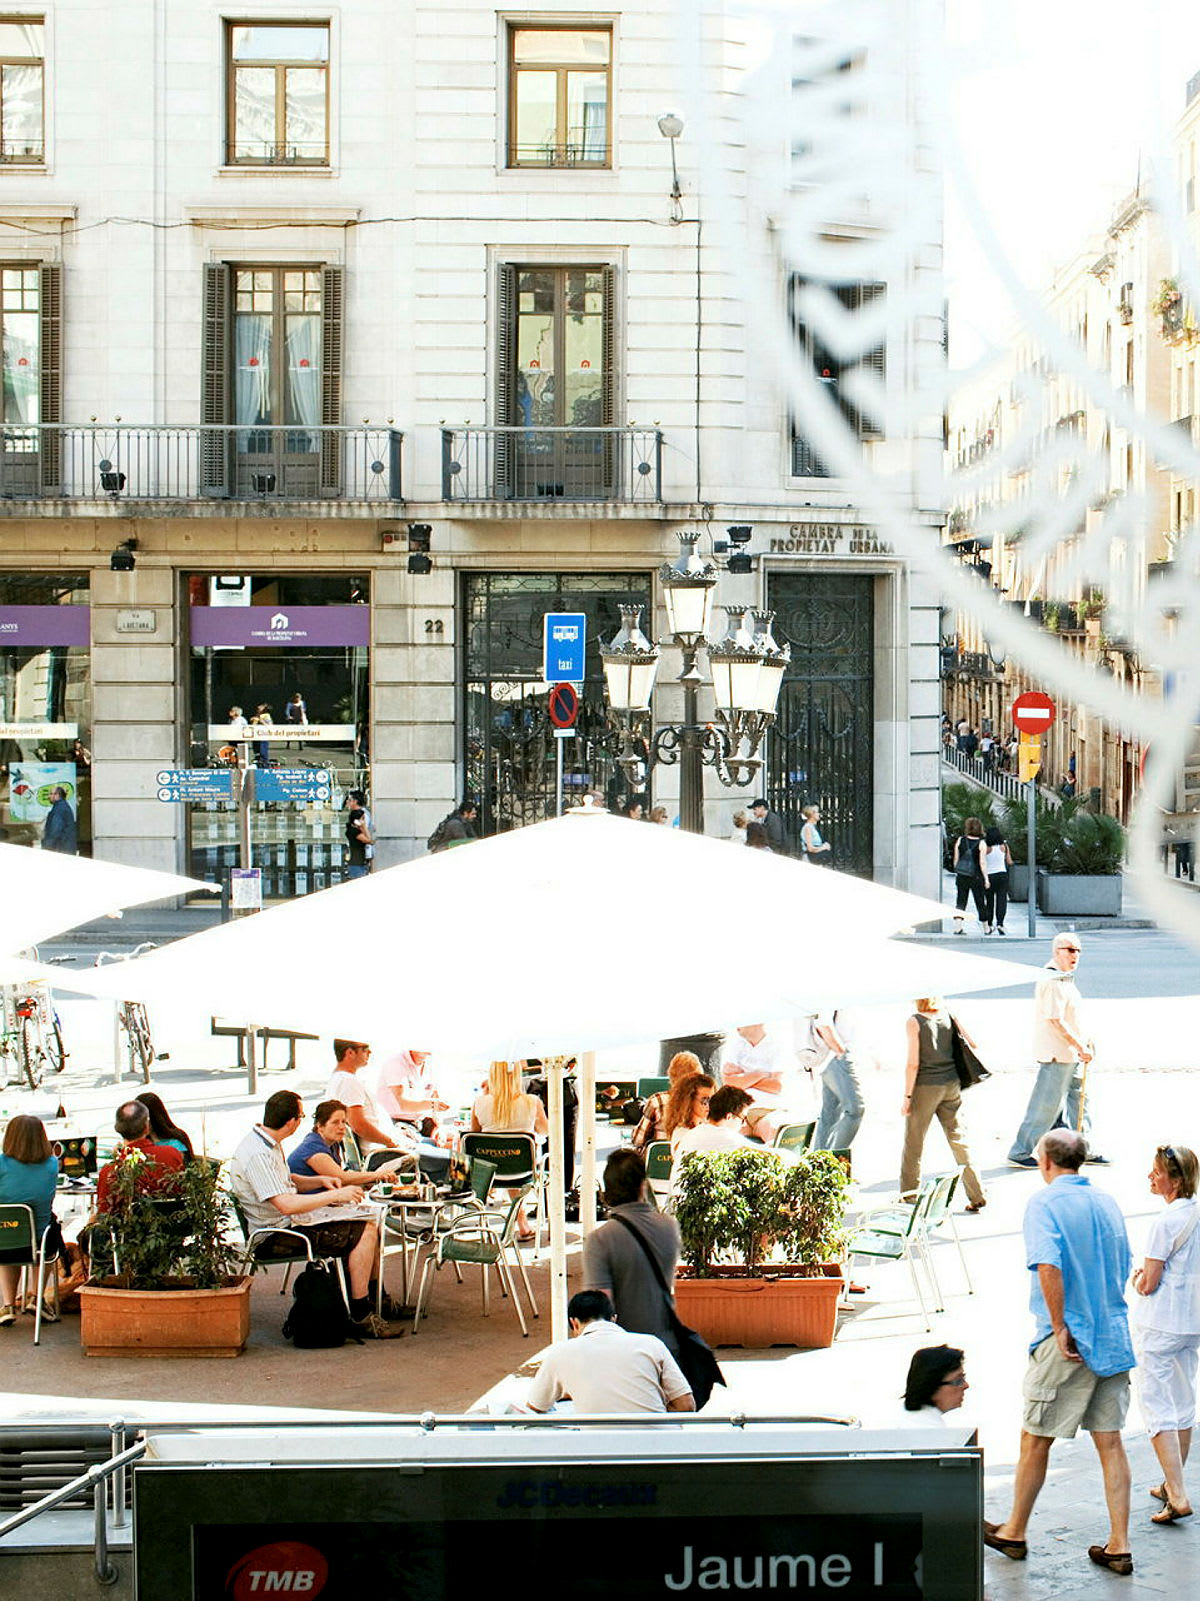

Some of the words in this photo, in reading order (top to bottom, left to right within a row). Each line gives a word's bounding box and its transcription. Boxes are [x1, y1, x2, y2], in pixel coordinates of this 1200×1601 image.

[789, 524, 843, 540] CAMBRA
[852, 528, 864, 540] DE
[866, 529, 879, 540] LA
[770, 539, 837, 553] PROPIETAT
[849, 541, 895, 554] URBANA
[424, 619, 444, 633] 22
[558, 658, 573, 670] taxi
[663, 1545, 853, 1592] Jaume
[249, 1570, 316, 1592] TMB
